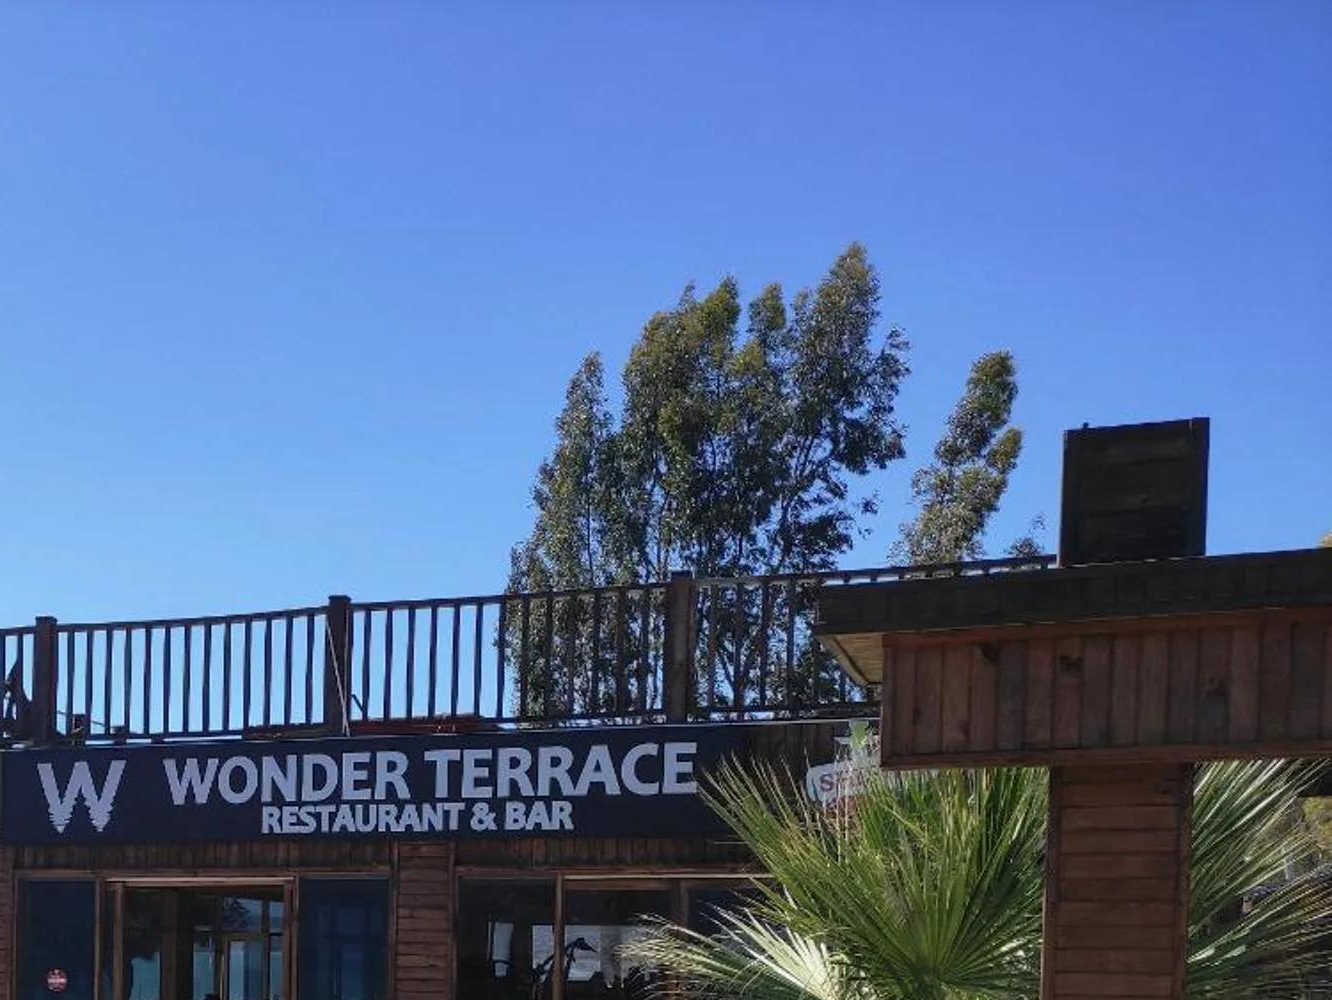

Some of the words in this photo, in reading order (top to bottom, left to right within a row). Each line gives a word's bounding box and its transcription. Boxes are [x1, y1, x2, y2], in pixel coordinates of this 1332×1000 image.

[163, 751, 411, 805] WONDER
[424, 742, 697, 798] TERRACE
[261, 802, 465, 833] RESTAURANT
[470, 802, 498, 831] &
[505, 800, 574, 831] BAR
